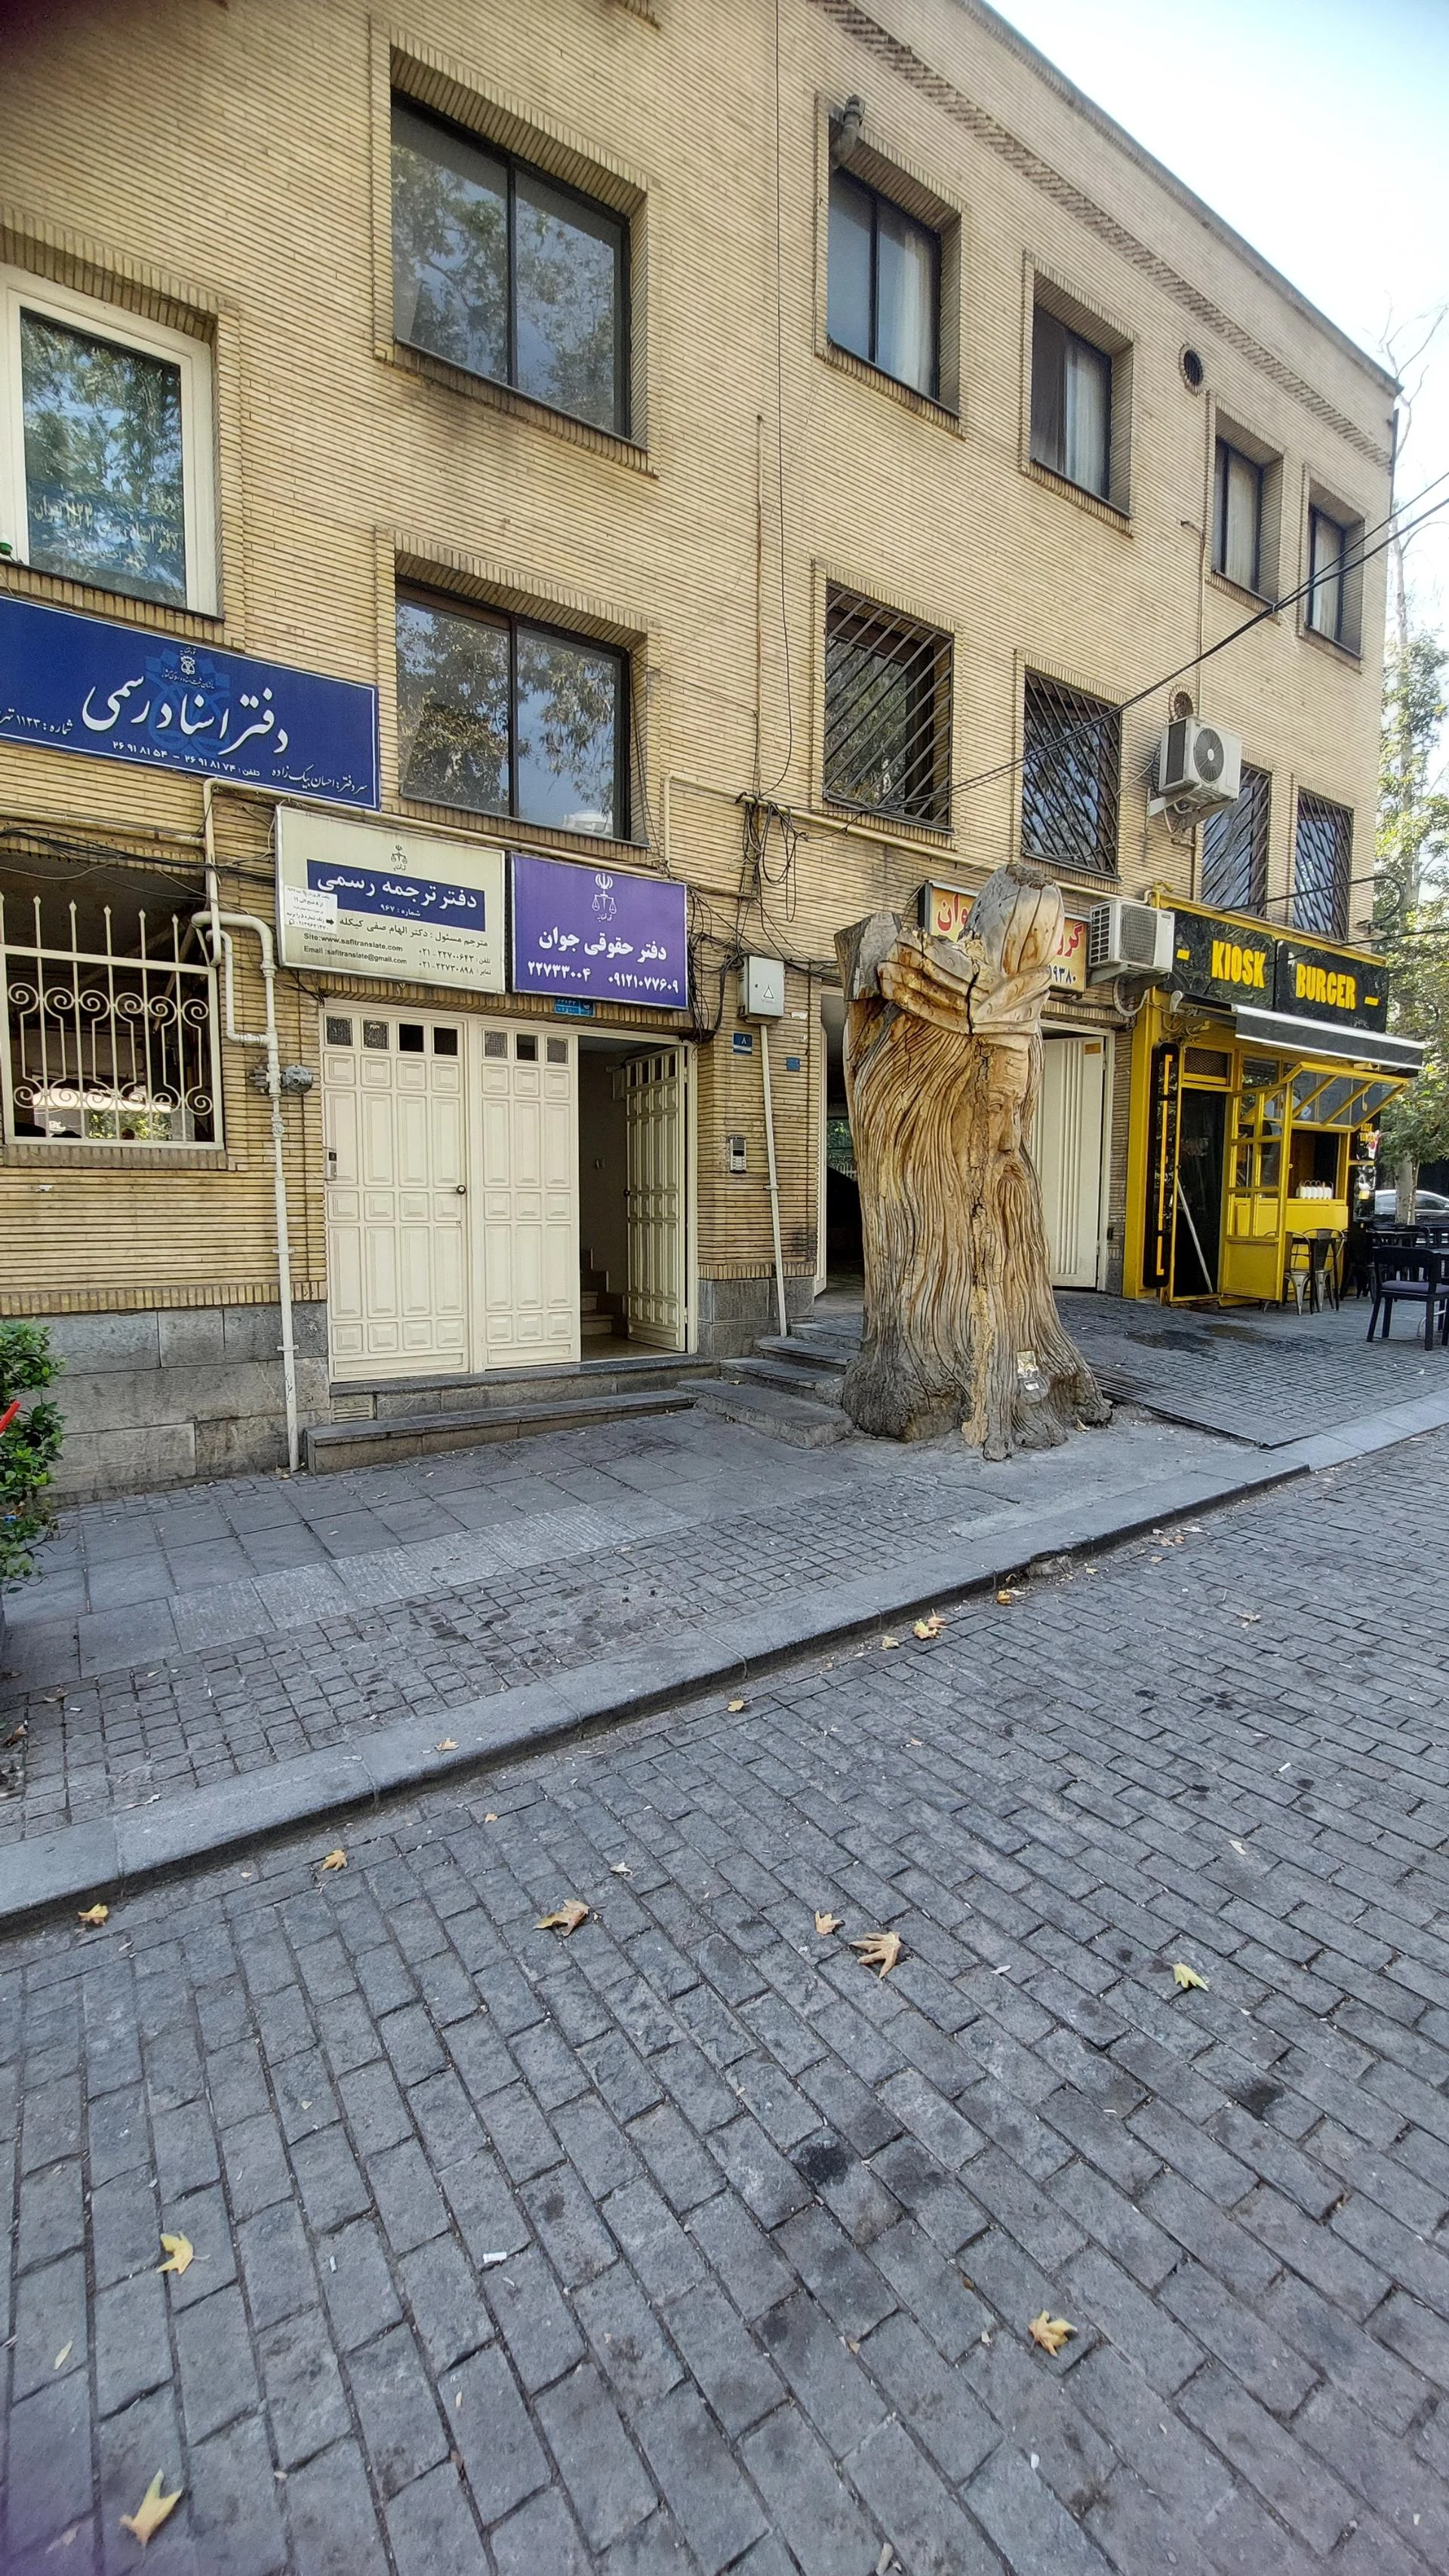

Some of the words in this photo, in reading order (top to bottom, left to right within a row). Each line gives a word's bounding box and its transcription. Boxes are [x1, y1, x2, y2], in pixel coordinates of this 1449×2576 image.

[82, 676, 150, 732] رسمی
[155, 694, 229, 740] اسناد
[217, 687, 289, 756] دفتر
[310, 776, 335, 788] احسان
[317, 875, 376, 896] رسمی
[382, 880, 437, 906] ترجمه
[380, 903, 395, 913] ۹۶۷
[438, 889, 477, 909] دفتر
[366, 922, 386, 932] صفی
[389, 924, 408, 936] الهام
[410, 928, 429, 938] دکتر
[463, 938, 488, 949] مترجم
[539, 926, 580, 953] جوان
[583, 932, 634, 959] حقوقی
[637, 940, 667, 962] دفتر
[528, 961, 591, 982] ۲۲۷۳۳۰۰۴
[608, 972, 679, 993] ۰۹۱۲۱۰۷۷۶۰۹
[1211, 940, 1266, 989] KIOSK
[1295, 963, 1355, 1011] BURGER
